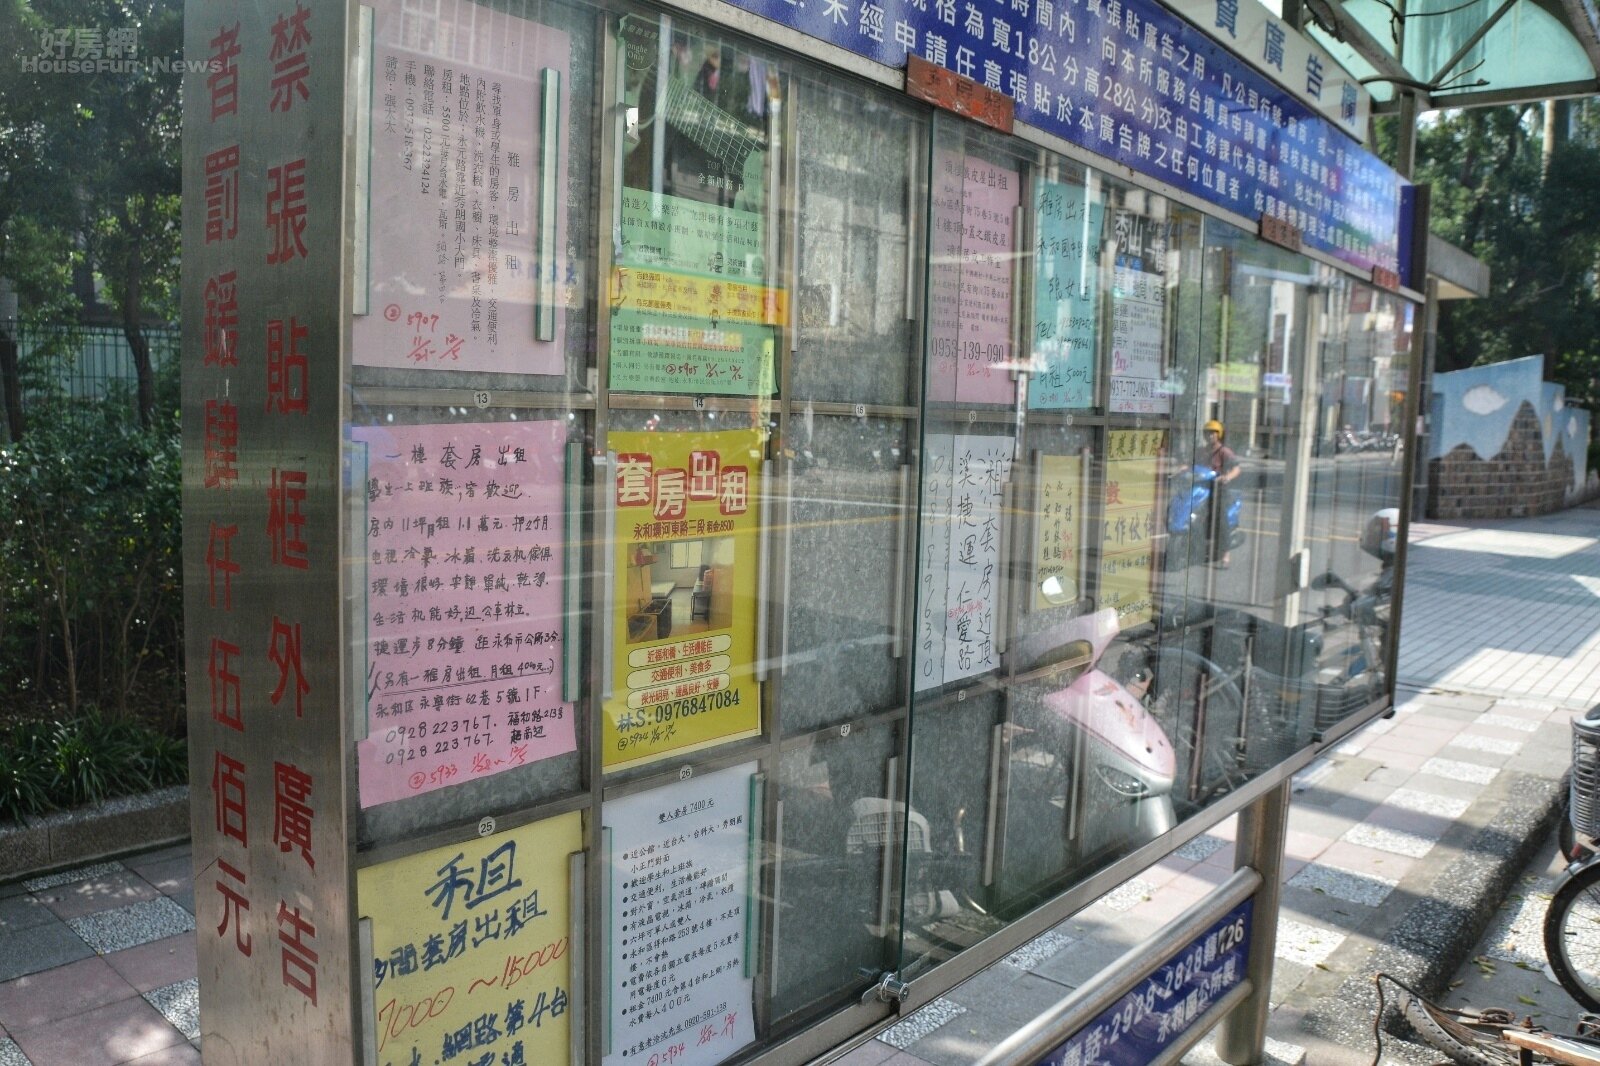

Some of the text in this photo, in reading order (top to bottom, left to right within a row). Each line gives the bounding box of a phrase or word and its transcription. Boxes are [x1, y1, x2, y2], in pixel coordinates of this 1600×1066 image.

[504, 152, 520, 270] 雅房出租
[407, 312, 439, 332] 5907
[931, 337, 1004, 362] 0953-139-090
[476, 393, 488, 404] 13
[695, 399, 704, 407] 14
[204, 20, 252, 957] 者罰鍰肆仟伍佰元
[616, 455, 748, 516] 套房出租
[266, 5, 318, 1007] 禁張貼框外廣告
[681, 769, 691, 778] 26
[481, 821, 493, 832] 25
[424, 840, 522, 920] 租
